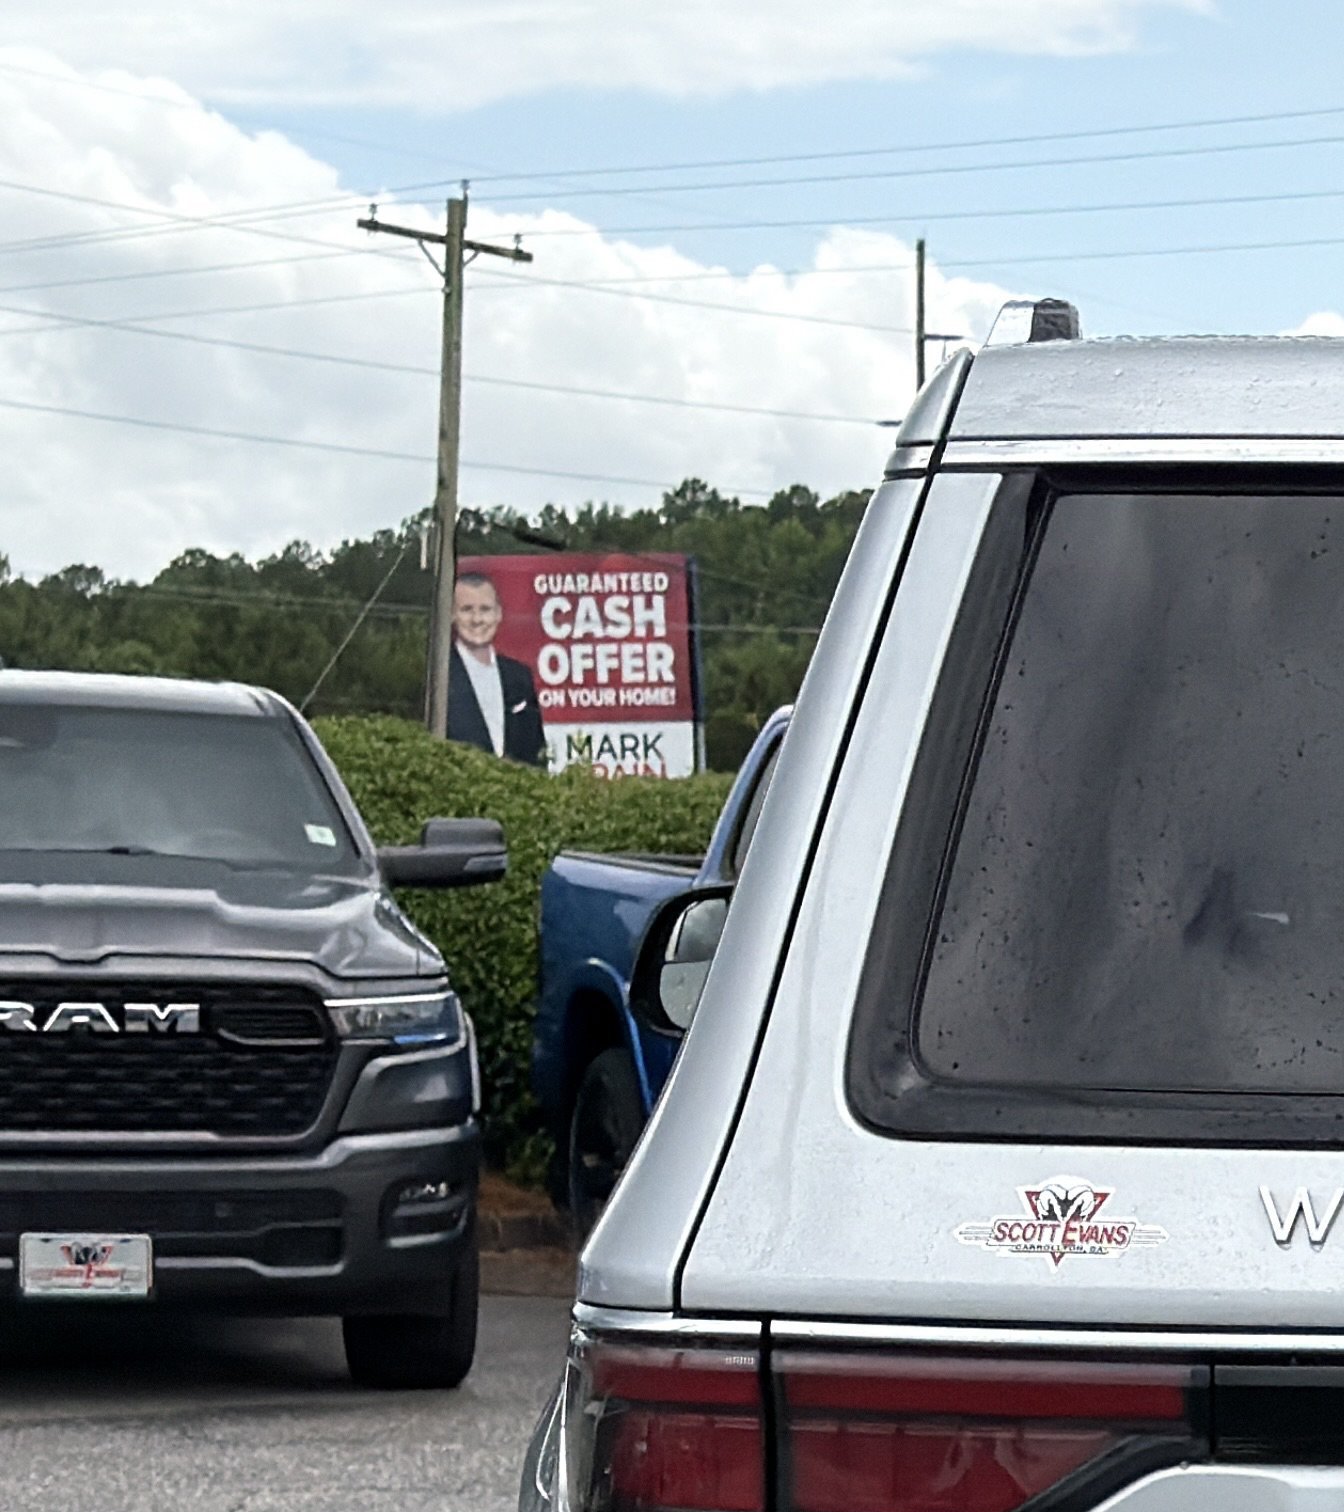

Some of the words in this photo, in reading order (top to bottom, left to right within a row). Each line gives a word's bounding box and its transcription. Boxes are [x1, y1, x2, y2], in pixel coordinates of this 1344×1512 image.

[534, 572, 669, 594] GUARANTEED
[541, 595, 667, 640] CASH
[537, 642, 675, 685] OFFER
[538, 689, 565, 707] ON
[568, 688, 617, 707] YOUR
[620, 687, 676, 706] HOME!
[567, 732, 664, 760] MARK
[994, 1222, 1060, 1243] SCOTT
[1061, 1217, 1129, 1245] EVANS
